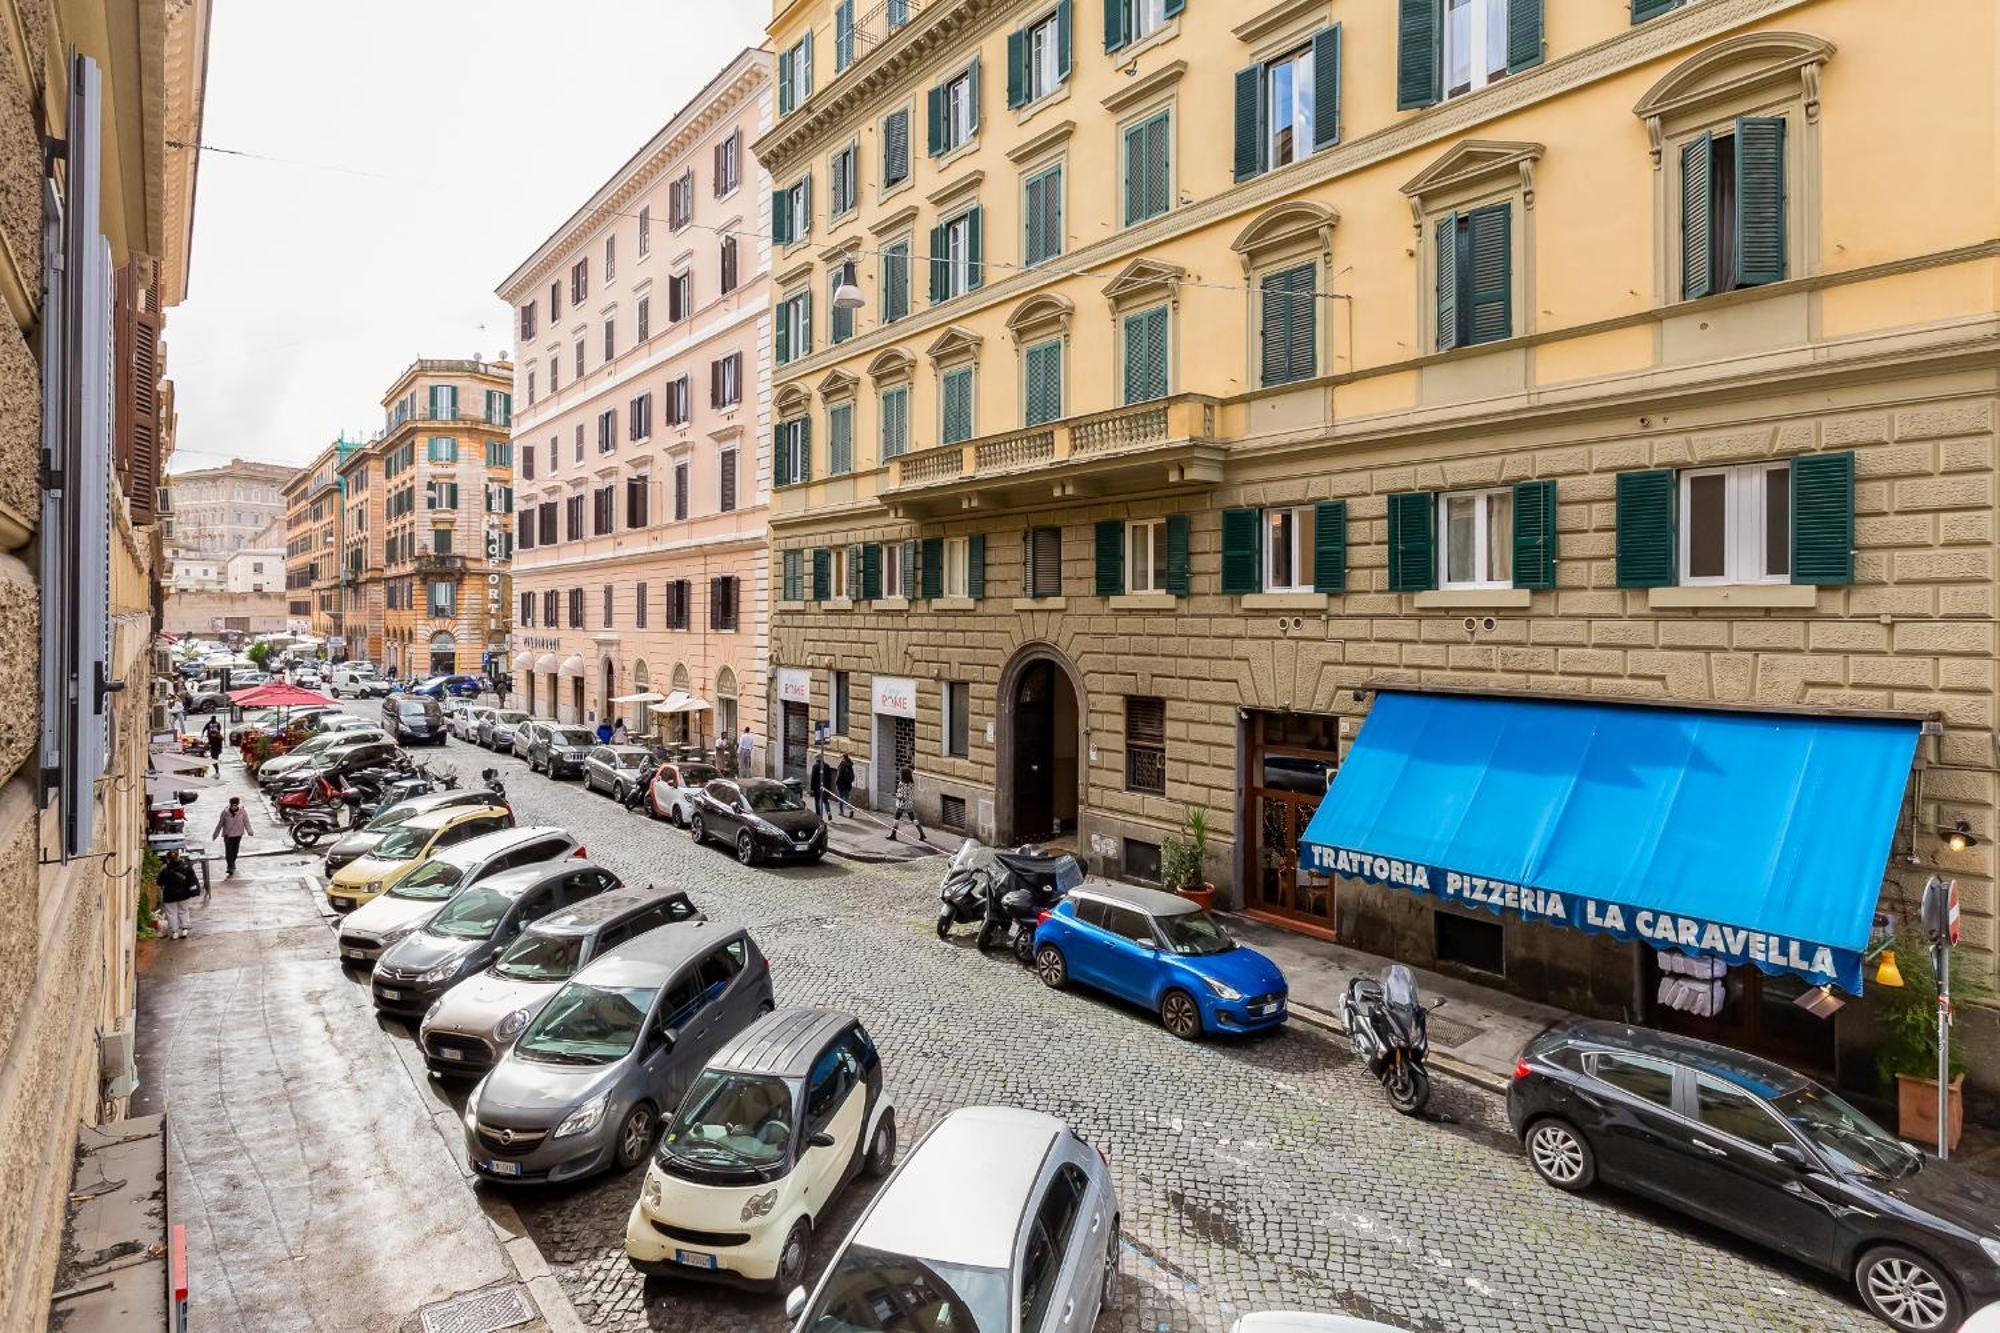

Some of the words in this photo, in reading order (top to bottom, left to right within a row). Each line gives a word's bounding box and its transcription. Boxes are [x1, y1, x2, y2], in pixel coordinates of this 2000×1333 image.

[882, 694, 907, 710] ROME
[1311, 845, 1430, 889] TRATTORIA
[1446, 872, 1566, 919] PIZZERIA
[1586, 900, 1626, 932] LA
[1635, 911, 1837, 978] CARAVELLA
